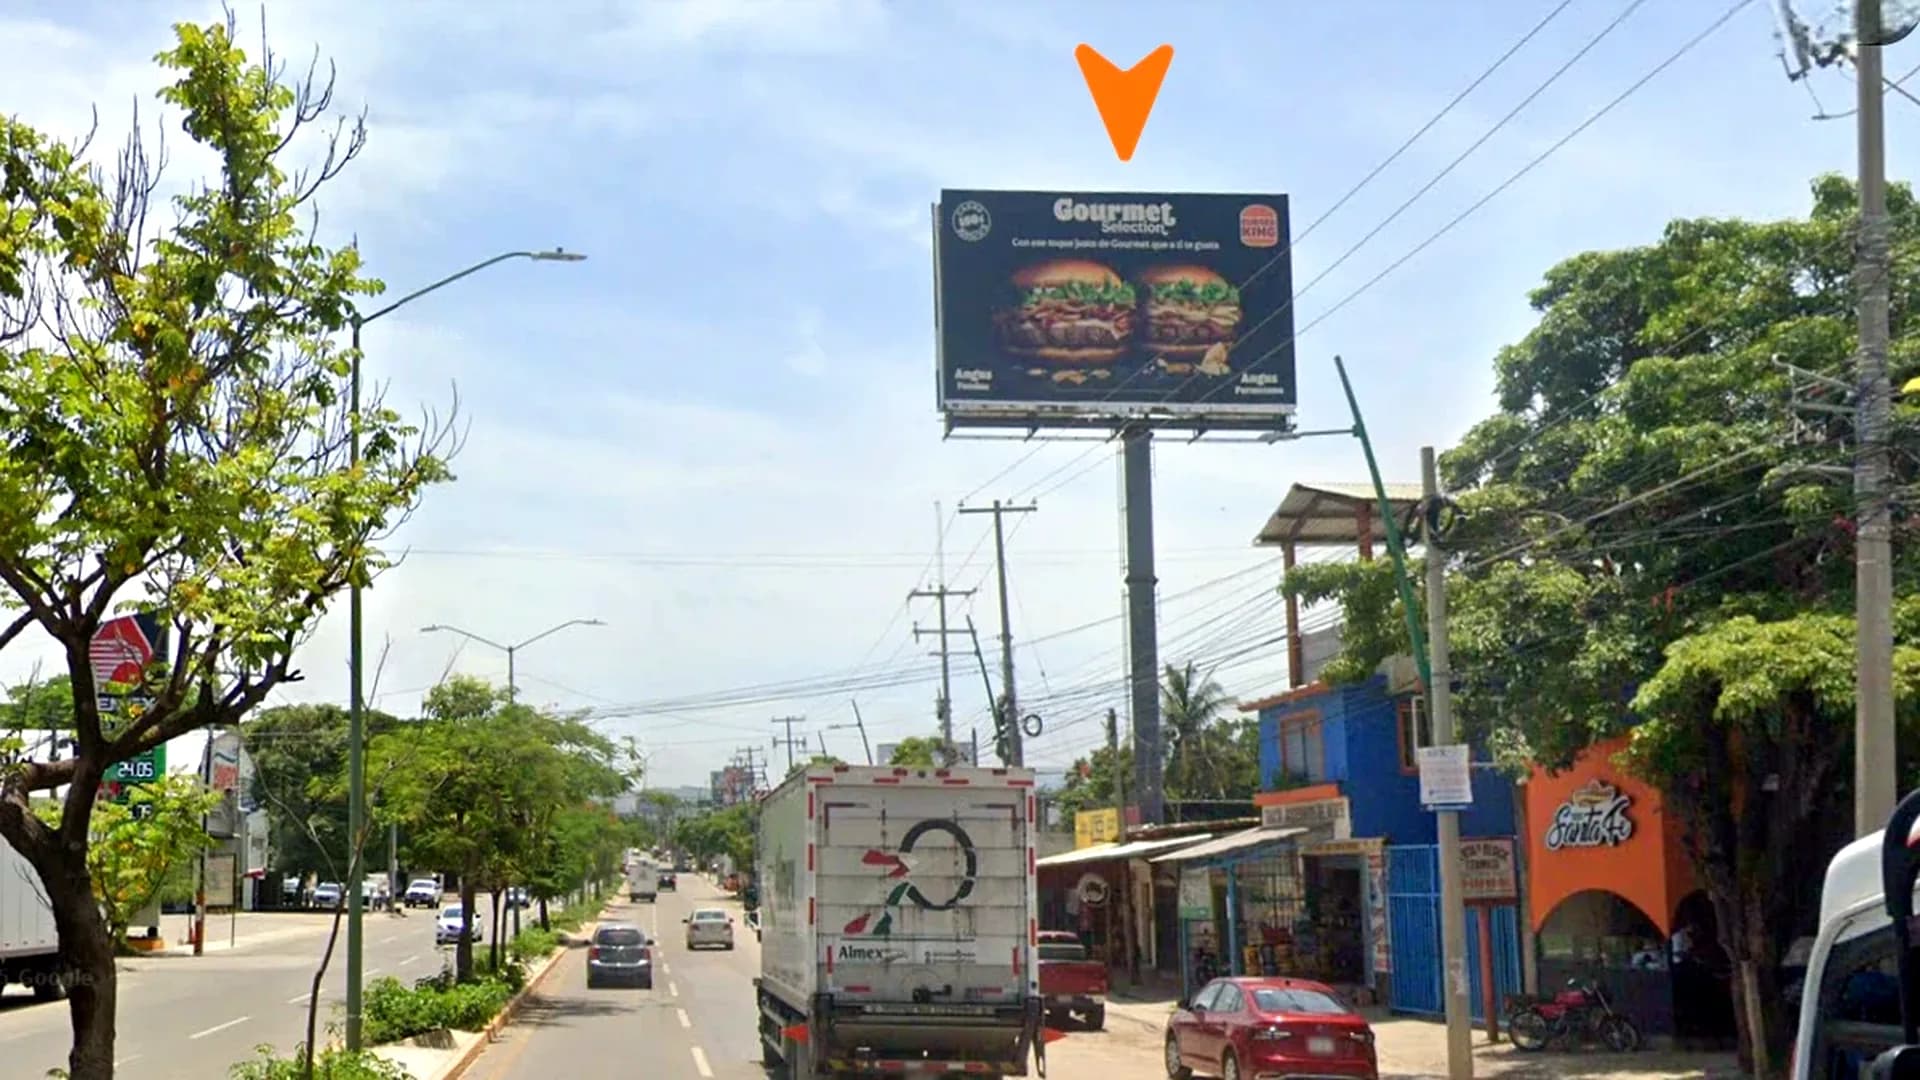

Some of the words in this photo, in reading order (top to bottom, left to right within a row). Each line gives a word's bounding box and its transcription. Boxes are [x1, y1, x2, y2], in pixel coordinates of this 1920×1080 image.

[1053, 198, 1176, 227] Gourmet
[1102, 221, 1169, 236] Selection
[1244, 226, 1275, 238] KING
[1012, 237, 1029, 248] Con
[1110, 239, 1149, 250] Gourmet
[1547, 804, 1603, 847] Santa
[838, 945, 882, 959] Almex
